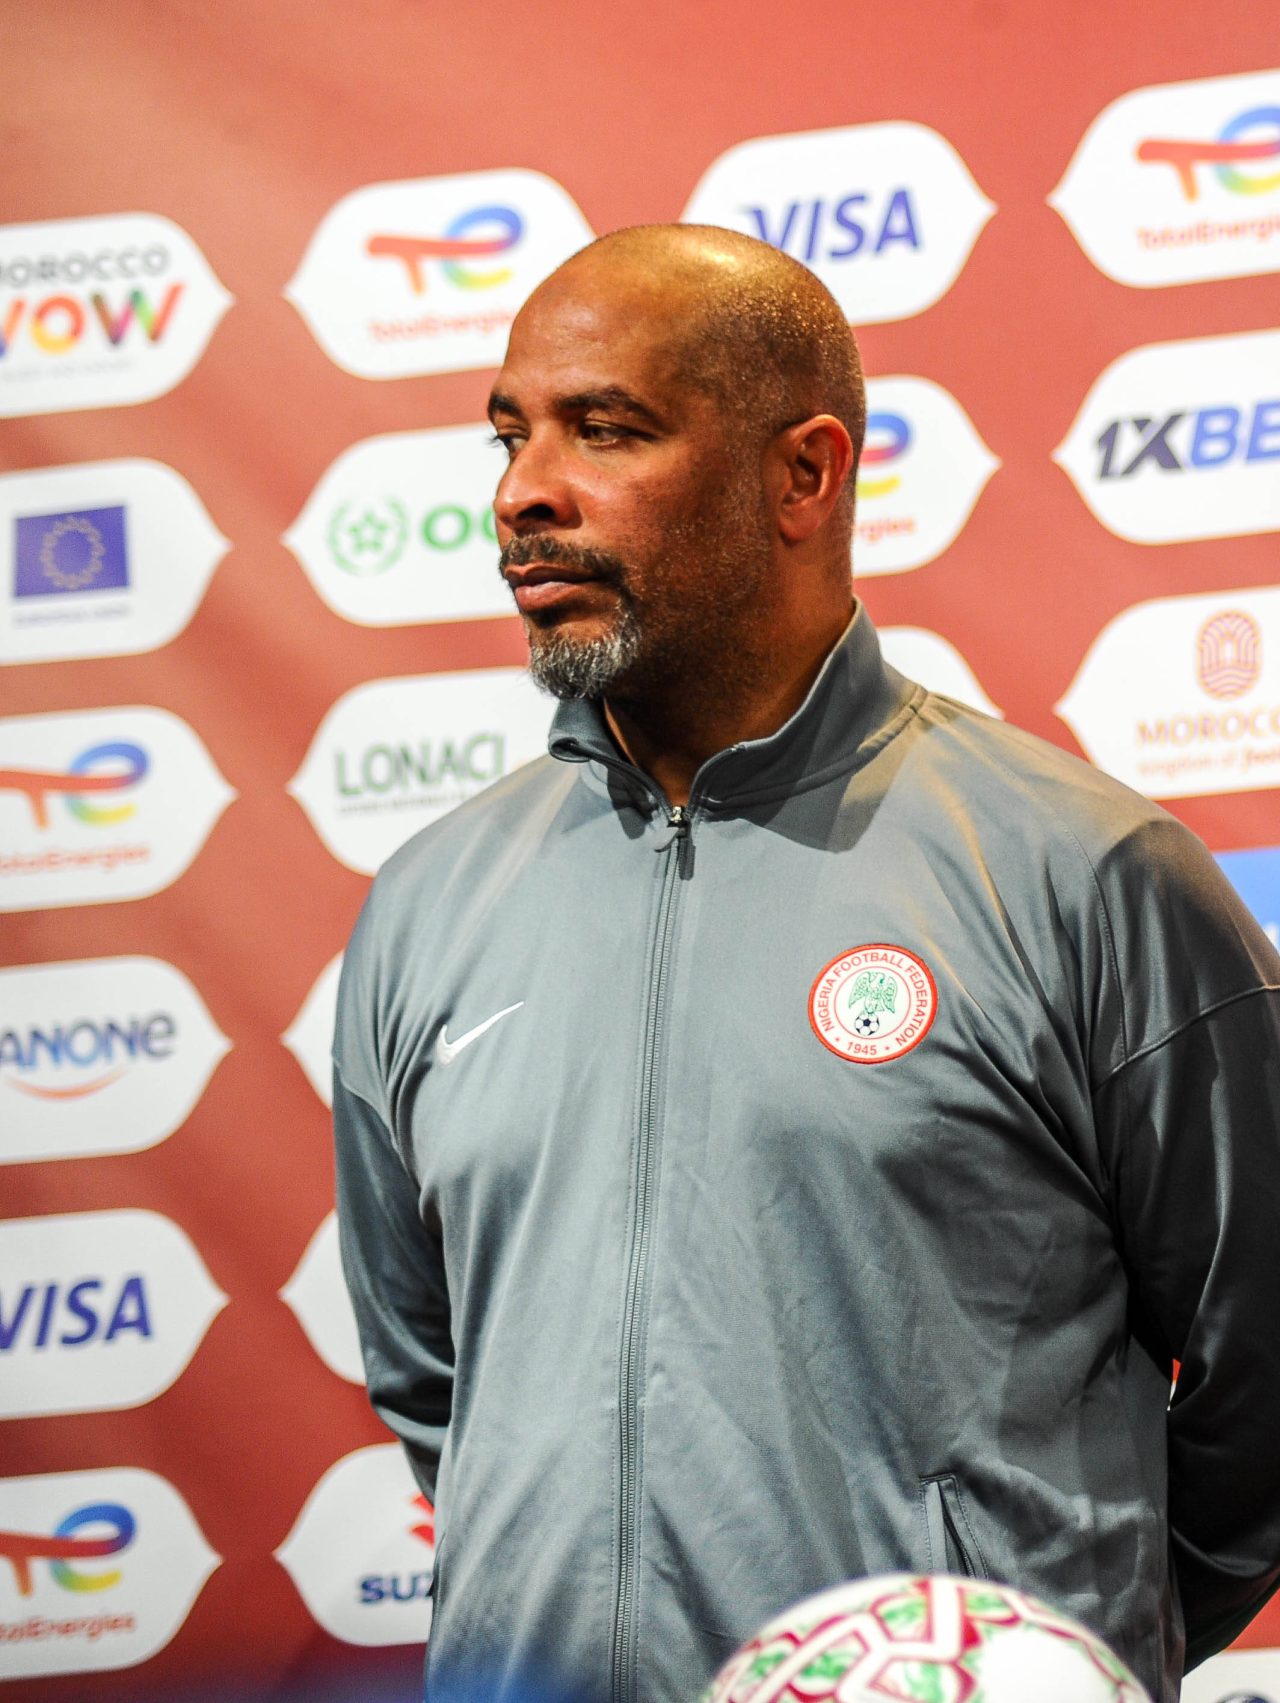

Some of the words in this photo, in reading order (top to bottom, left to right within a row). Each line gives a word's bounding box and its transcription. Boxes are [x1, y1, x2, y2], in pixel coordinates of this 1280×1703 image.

[744, 188, 925, 263] VISA
[0, 245, 170, 289] OROCCO
[0, 284, 184, 356] OW
[336, 734, 505, 796] LONACI
[818, 978, 836, 1032] NIGERIA
[833, 952, 904, 978] FOOTBALL
[896, 965, 928, 1046] FEDERATION
[847, 1041, 878, 1056] 1945
